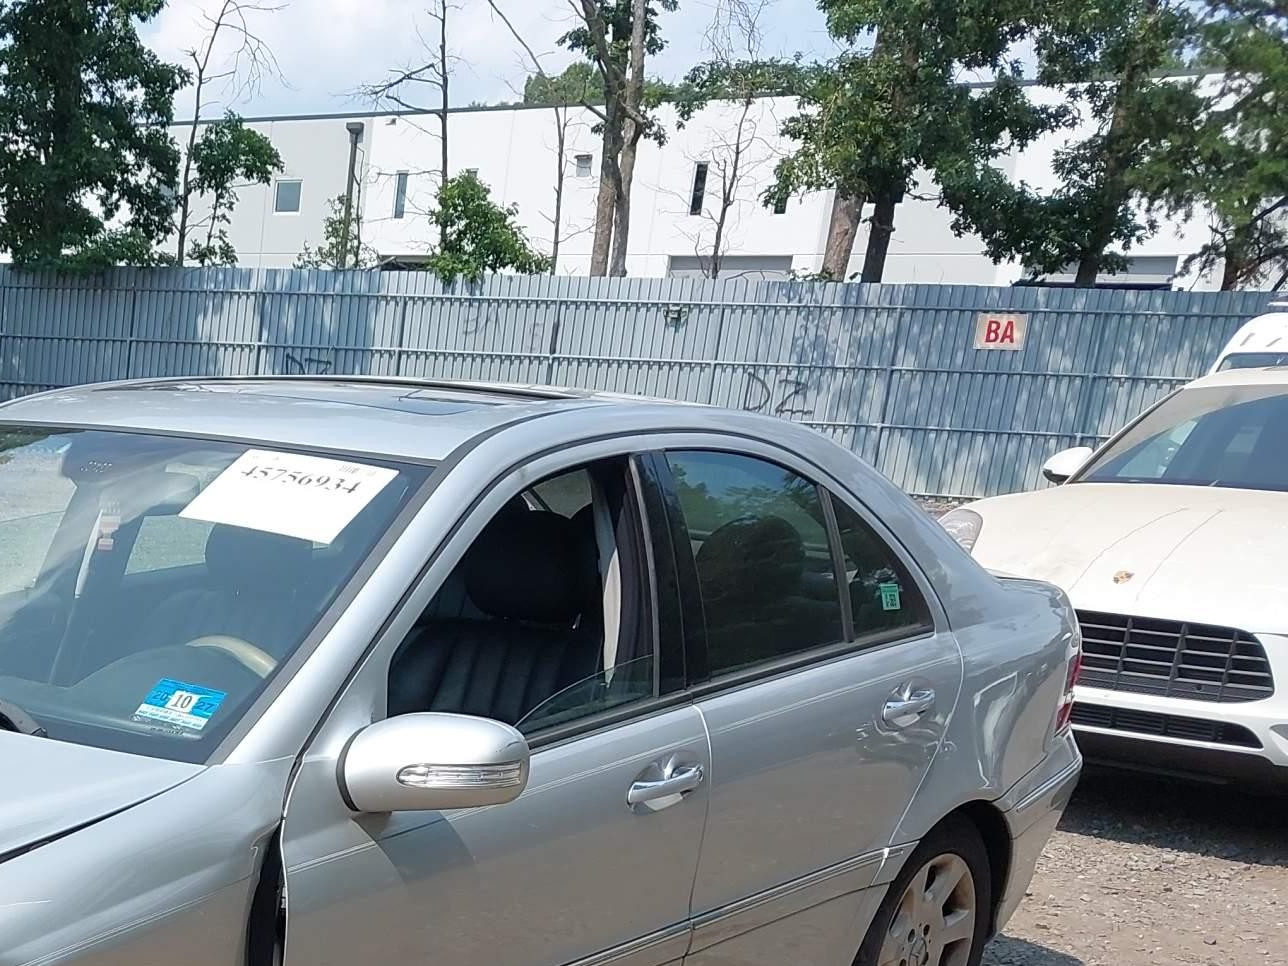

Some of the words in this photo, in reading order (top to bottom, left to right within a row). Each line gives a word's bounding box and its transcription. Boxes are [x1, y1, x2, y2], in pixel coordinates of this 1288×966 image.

[985, 320, 1015, 343] BA
[240, 465, 361, 494] 45756934
[152, 690, 169, 702] 20
[170, 693, 193, 709] 10
[195, 701, 215, 712] 27
